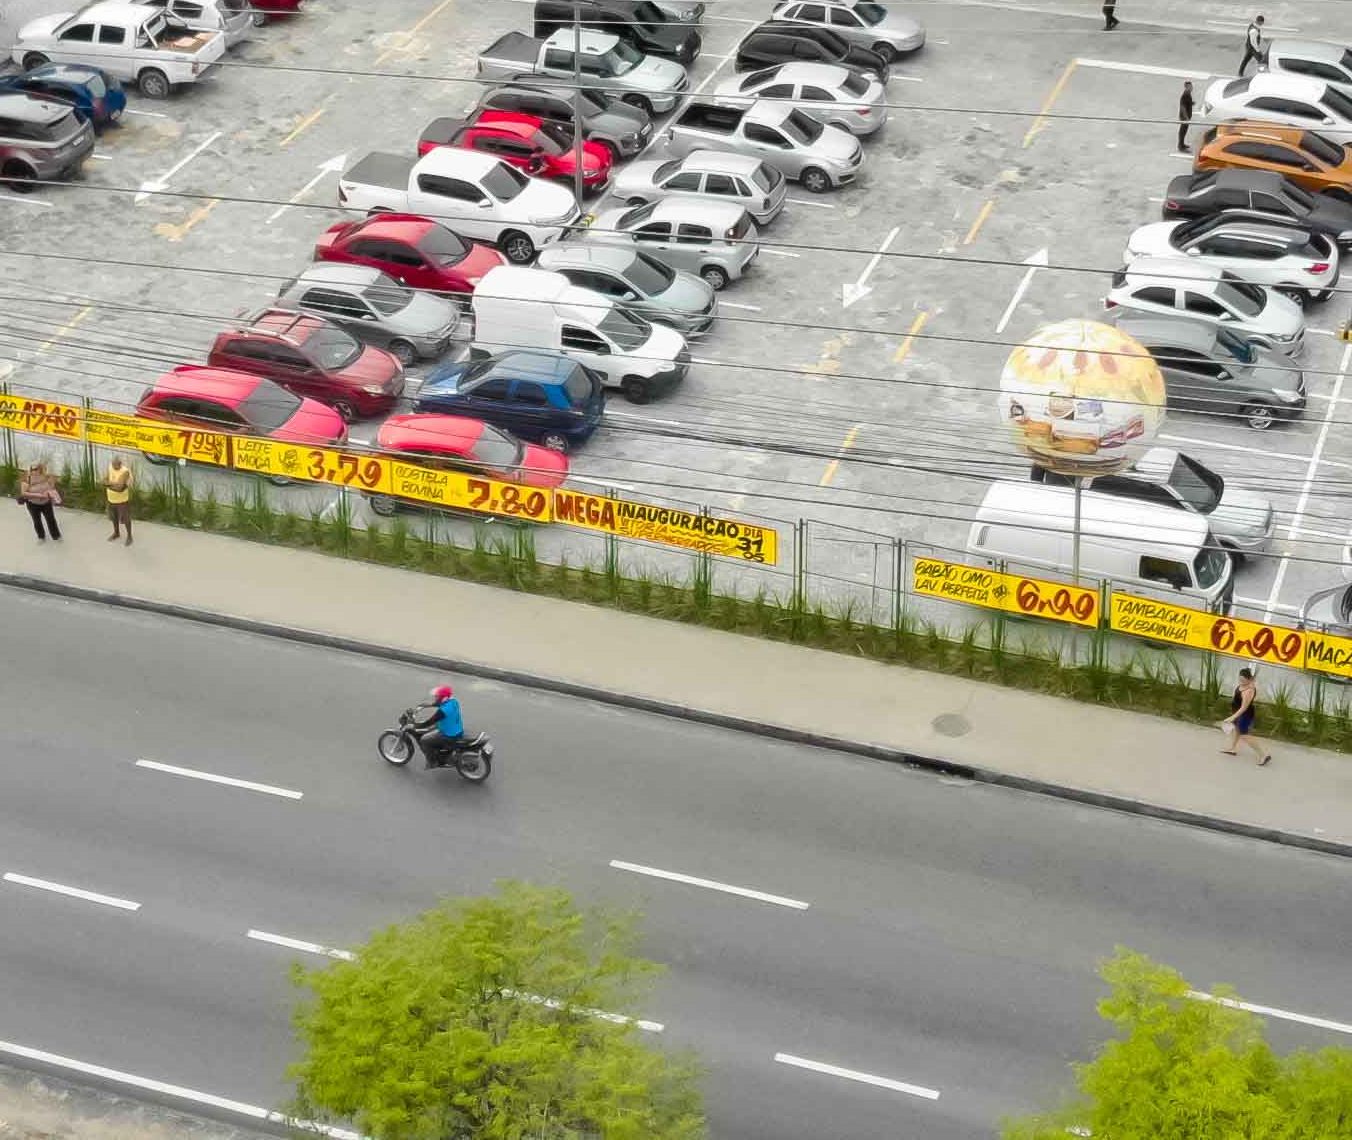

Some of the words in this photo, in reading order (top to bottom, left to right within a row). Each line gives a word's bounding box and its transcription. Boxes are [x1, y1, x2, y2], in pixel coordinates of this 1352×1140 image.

[237, 439, 272, 454] LEITE
[395, 466, 448, 485] COSTELA
[401, 481, 444, 500] BOVINA
[555, 494, 616, 530] MEGA
[743, 527, 763, 538] DIA
[736, 537, 764, 553] 31
[961, 572, 993, 589] OMO
[941, 581, 989, 603] PERFEITA
[1115, 598, 1191, 626] TAMBAQUI
